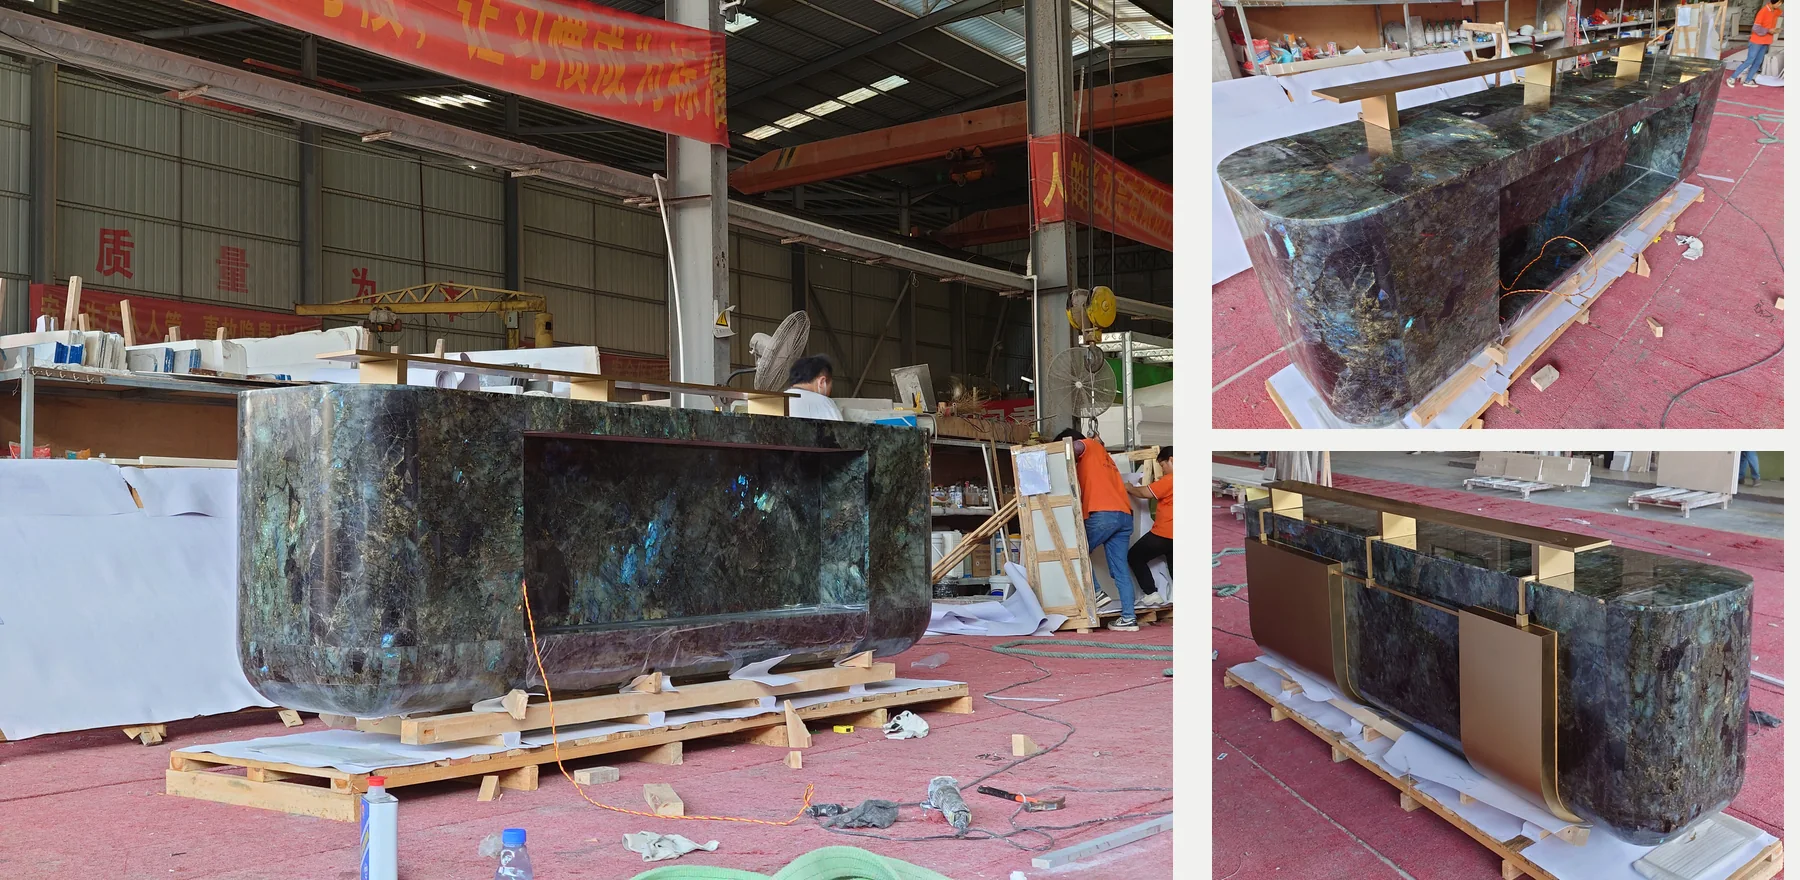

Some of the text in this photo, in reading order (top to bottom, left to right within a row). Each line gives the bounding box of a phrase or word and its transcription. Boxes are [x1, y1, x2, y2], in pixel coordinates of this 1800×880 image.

[323, 0, 727, 129] ，让习惯成为标准
[96, 228, 135, 279] 质
[216, 246, 249, 293] 量
[352, 268, 376, 304] 为
